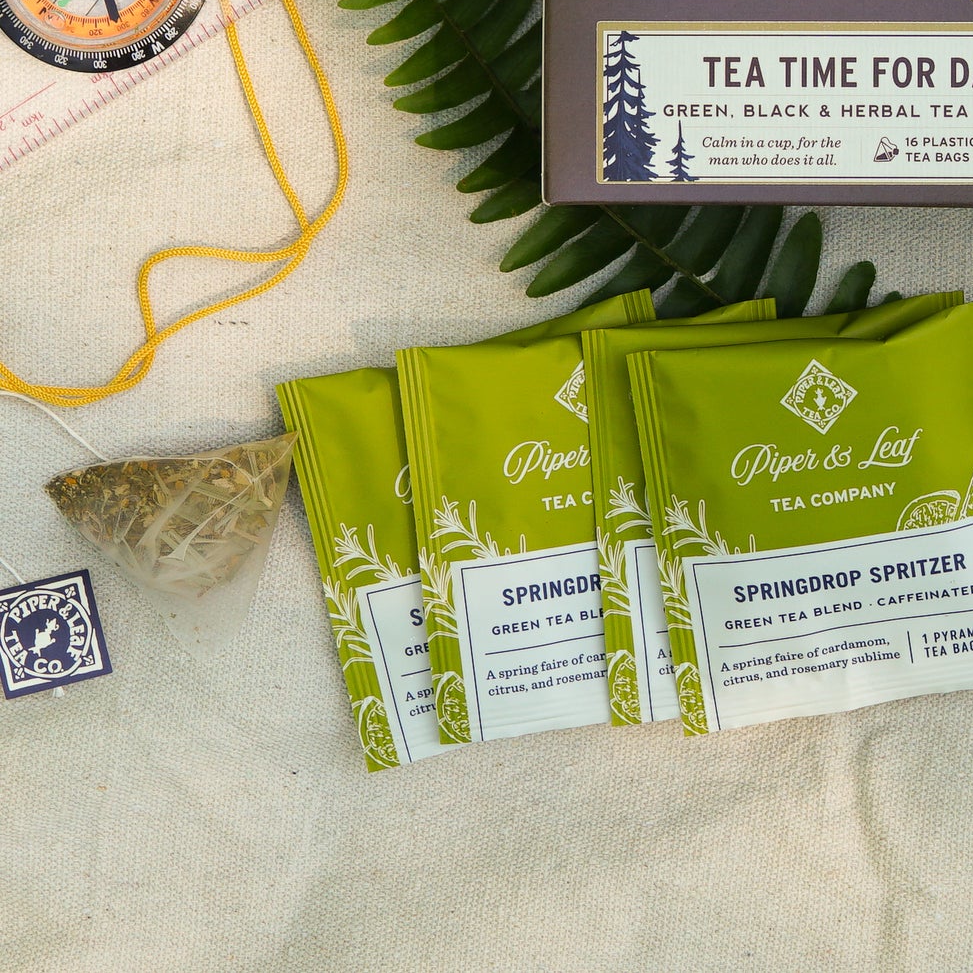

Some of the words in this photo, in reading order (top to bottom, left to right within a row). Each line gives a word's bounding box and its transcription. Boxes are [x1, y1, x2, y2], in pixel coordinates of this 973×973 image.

[55, 55, 68, 65] 320
[94, 60, 107, 68] 300
[703, 57, 766, 88] TEA
[779, 57, 858, 88] TIME
[873, 57, 936, 88] FOR
[663, 104, 734, 119] GREEN,
[744, 104, 810, 118] BLACK
[820, 104, 832, 118] &
[841, 105, 921, 118] HERBAL
[931, 105, 969, 118] TEA
[702, 136, 738, 149] Calm
[741, 137, 754, 149] in
[756, 140, 765, 149] a
[767, 139, 794, 152] cup,
[797, 137, 816, 152] for
[820, 137, 841, 149] the
[905, 138, 918, 147] 16
[709, 156, 738, 166] man
[741, 154, 768, 166] who
[770, 154, 800, 166] does
[802, 154, 813, 166] it
[816, 154, 838, 166] all.
[906, 152, 931, 162] TEA
[935, 152, 970, 162] BAGS
[730, 443, 820, 486] Piper
[823, 445, 851, 468] &
[859, 426, 923, 468] Leaf
[770, 497, 805, 513] TEA
[811, 482, 896, 507] COMPANY
[734, 570, 861, 604] SPRINGDROP
[870, 553, 966, 584] SPRITZER
[9, 595, 60, 623] PIPER
[59, 604, 72, 619] &
[725, 616, 773, 630] GREEN
[779, 611, 808, 624] TEA
[814, 601, 863, 617] BLEND
[922, 634, 928, 644] 1
[5, 630, 29, 665] TEA
[34, 658, 64, 673] CO.
[721, 663, 730, 672] A
[732, 653, 773, 672] spring
[775, 648, 804, 663] faire
[806, 647, 819, 658] of
[822, 635, 889, 656] cardamom,
[924, 645, 948, 658] TEA
[723, 673, 763, 687] citrus,
[766, 666, 789, 681] and
[791, 656, 849, 678] rosemary
[851, 649, 900, 665] sublime
